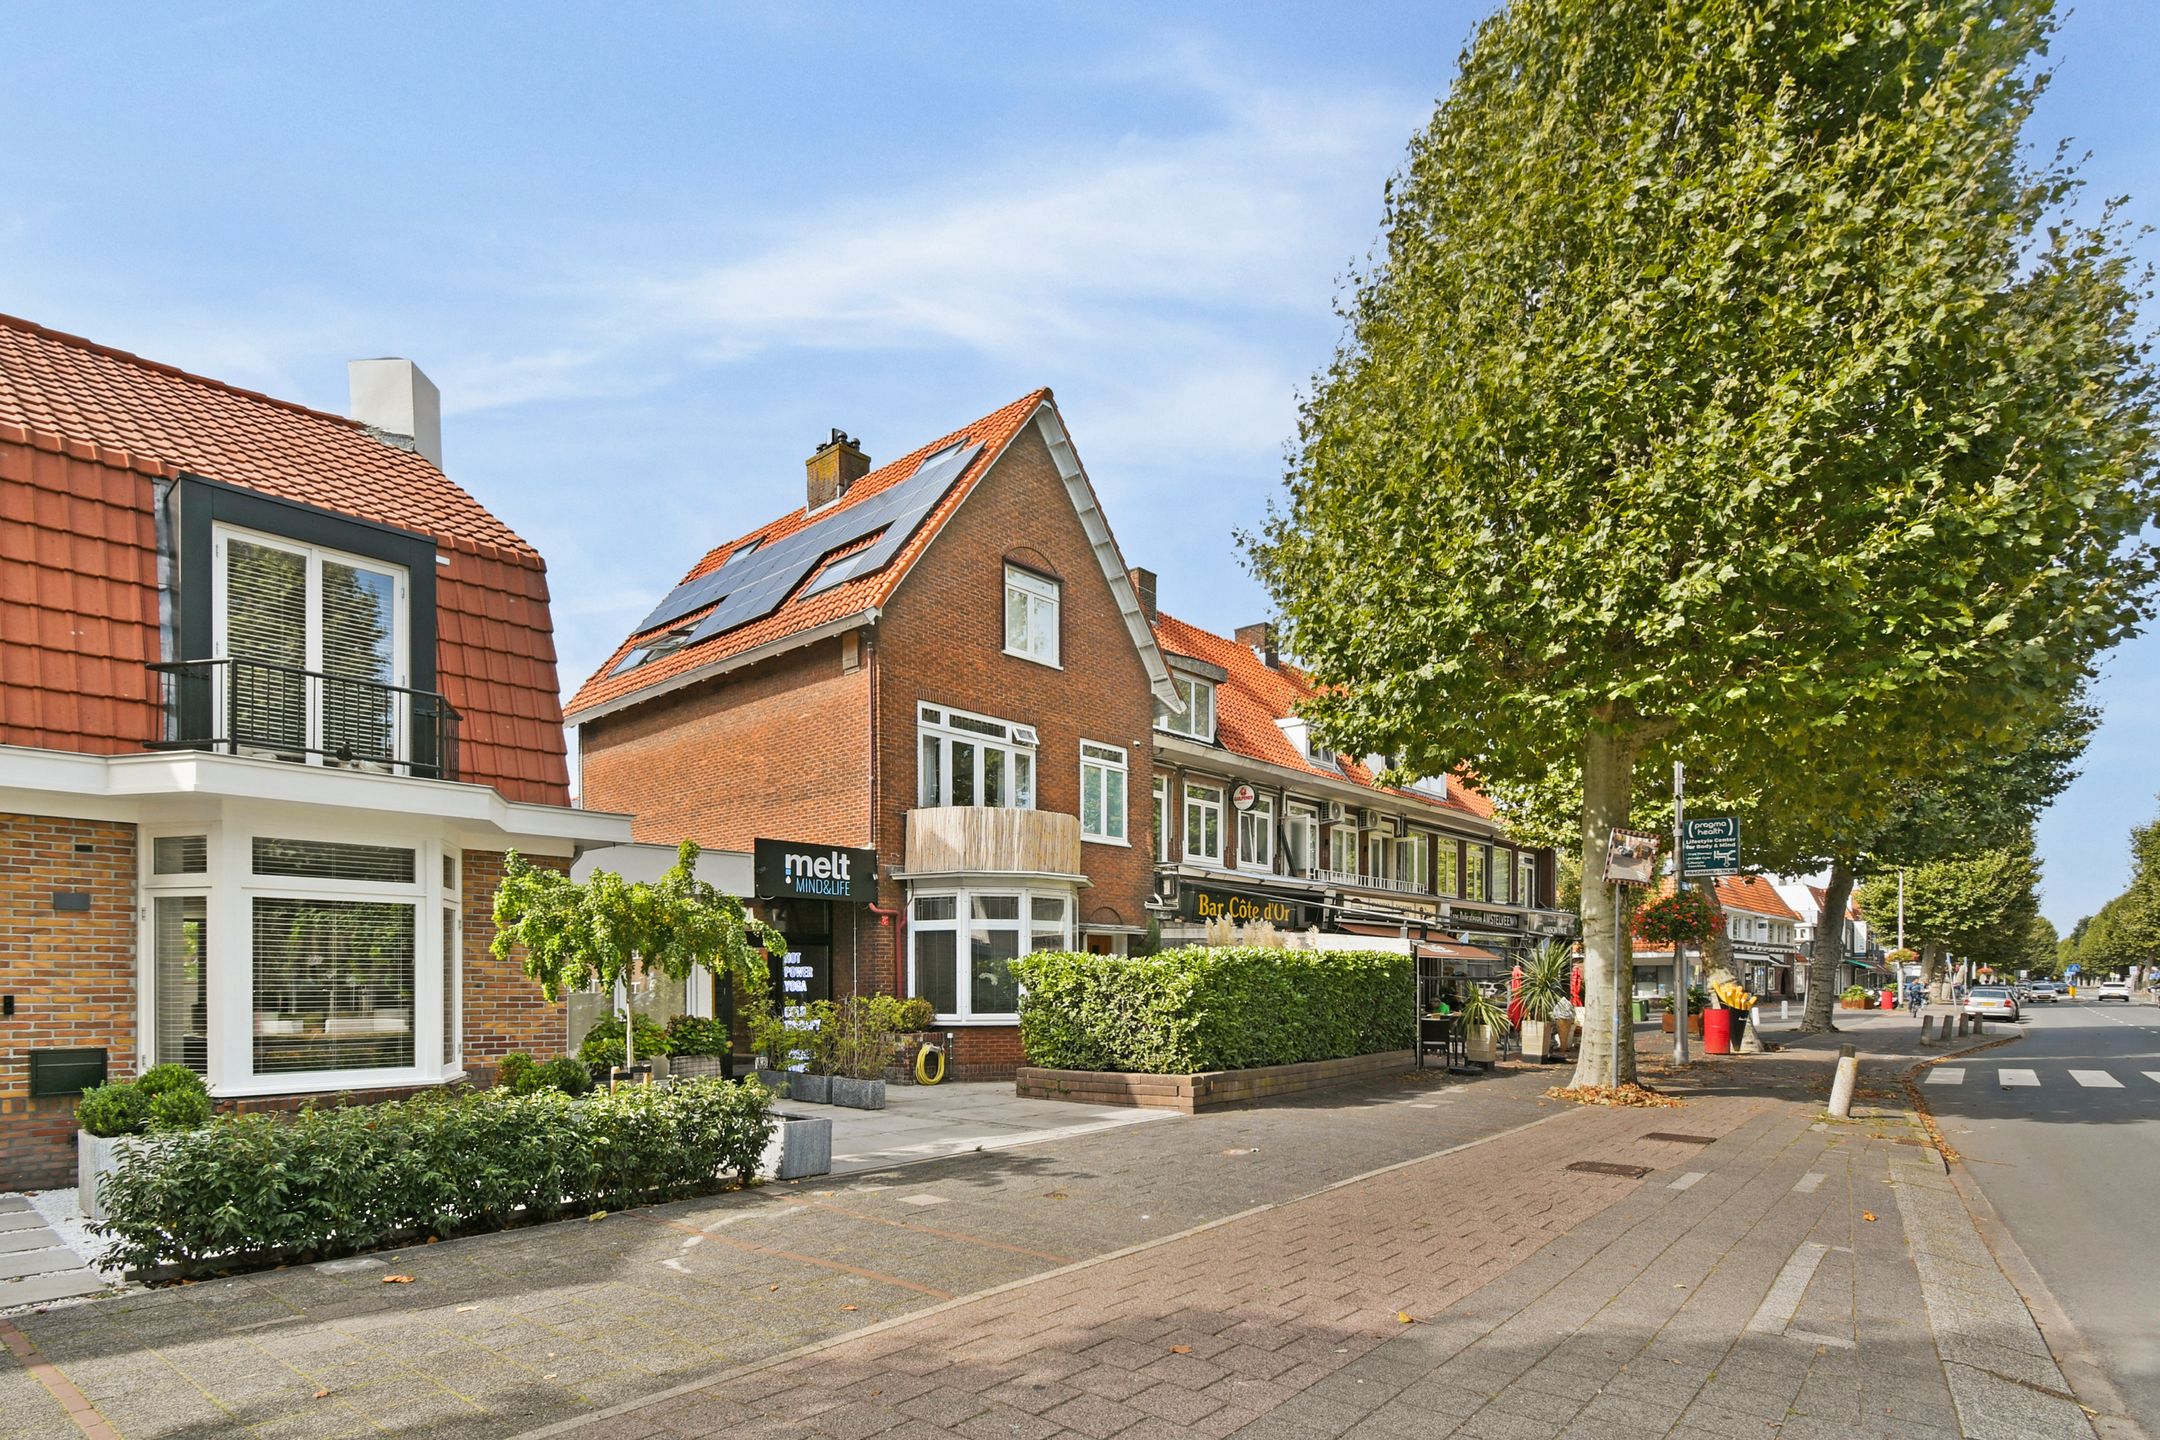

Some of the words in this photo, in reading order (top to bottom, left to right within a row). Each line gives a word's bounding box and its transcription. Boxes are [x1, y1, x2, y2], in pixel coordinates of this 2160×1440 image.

[1695, 821, 1726, 830] pragma
[785, 851, 850, 880] melt
[795, 878, 851, 896] MIND&LIFE
[1199, 893, 1224, 917] Bar
[1229, 896, 1259, 919] Côte
[1264, 902, 1290, 921] d'Or
[783, 966, 813, 978] POWER
[783, 980, 807, 992] YOGA
